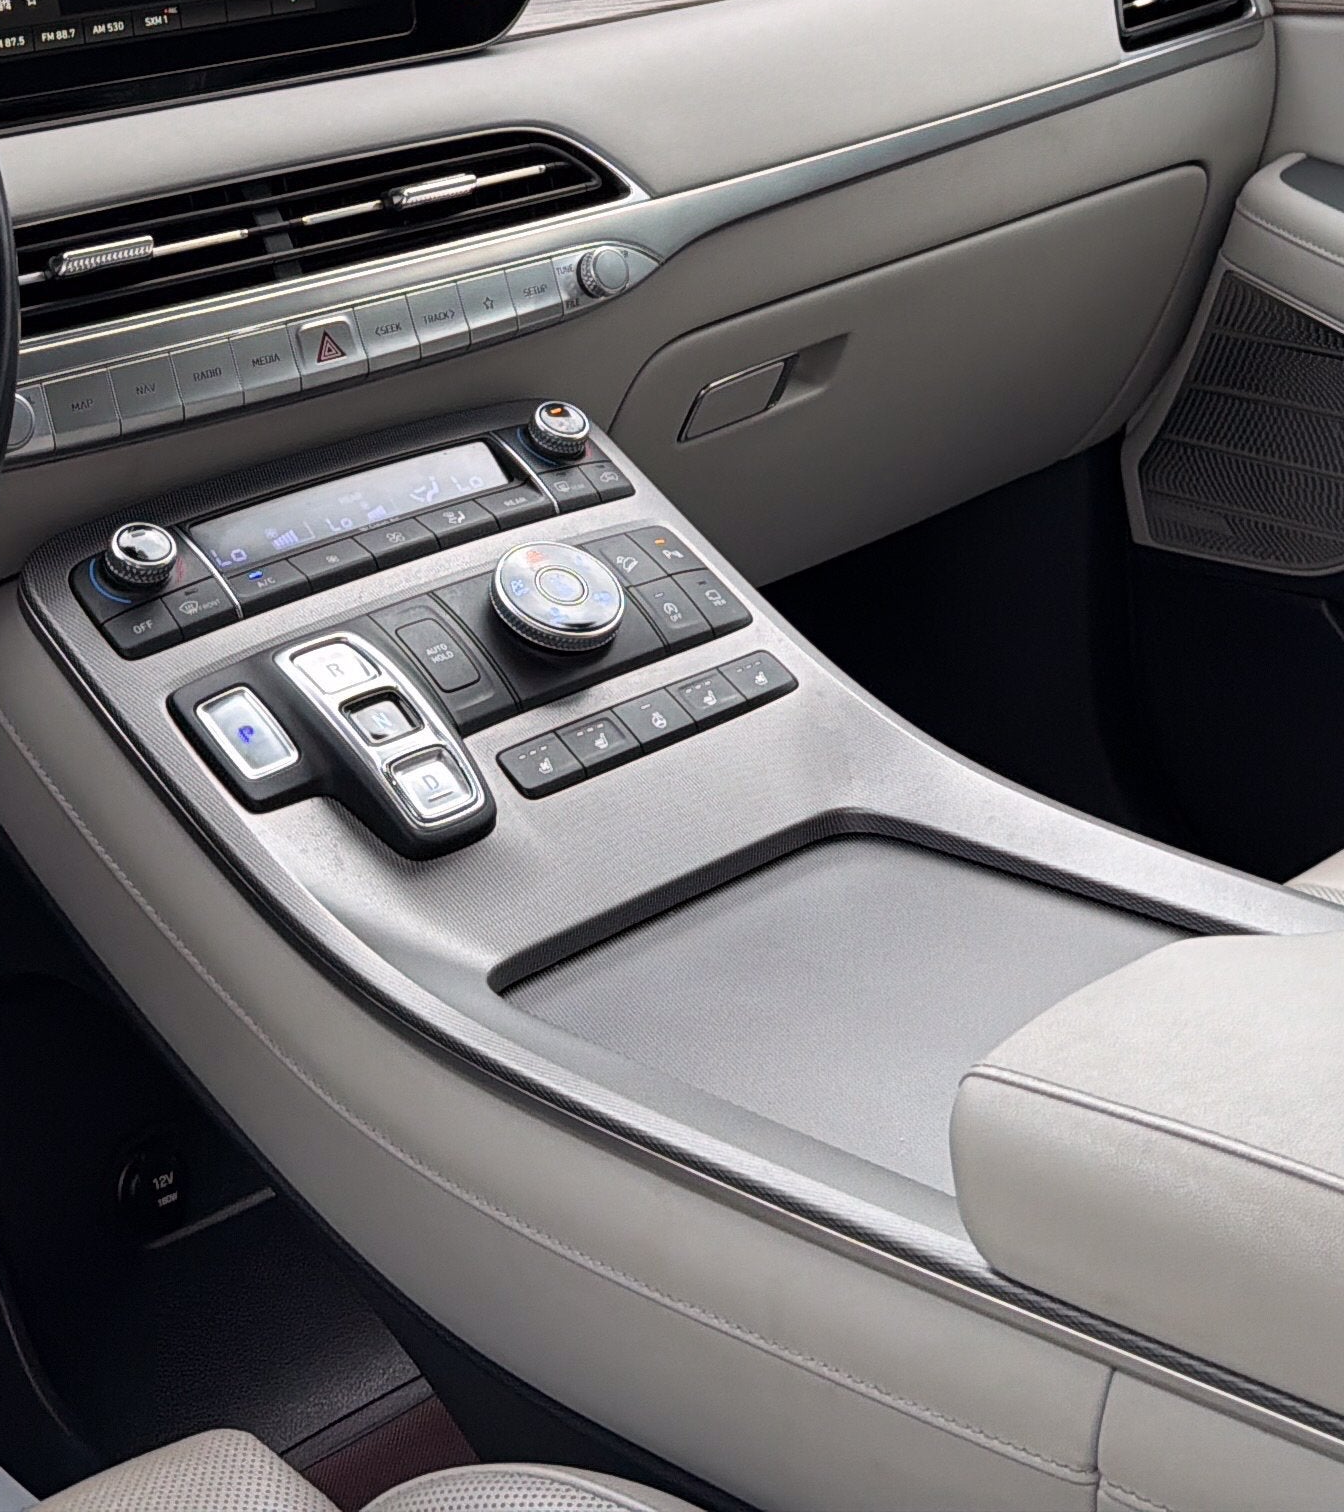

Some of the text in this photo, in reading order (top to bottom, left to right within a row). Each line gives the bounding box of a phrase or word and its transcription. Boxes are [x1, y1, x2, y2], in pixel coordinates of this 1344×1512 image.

[92, 21, 124, 35] AM 530
[144, 16, 163, 27] SXM
[5, 36, 25, 47] 87.5
[41, 28, 76, 42] FM 88.7
[523, 284, 548, 297] SETUP
[251, 352, 281, 368] MEDIA
[192, 366, 223, 383] RADIO
[135, 384, 156, 396] NAV
[70, 399, 94, 413] MAP
[257, 577, 277, 589] A/C
[132, 619, 154, 635] OFF
[426, 643, 448, 657] AUTO
[430, 650, 455, 665] HOLD
[326, 663, 346, 677] R
[370, 711, 393, 729] N
[422, 774, 440, 790] D
[152, 1170, 174, 1190] 12V
